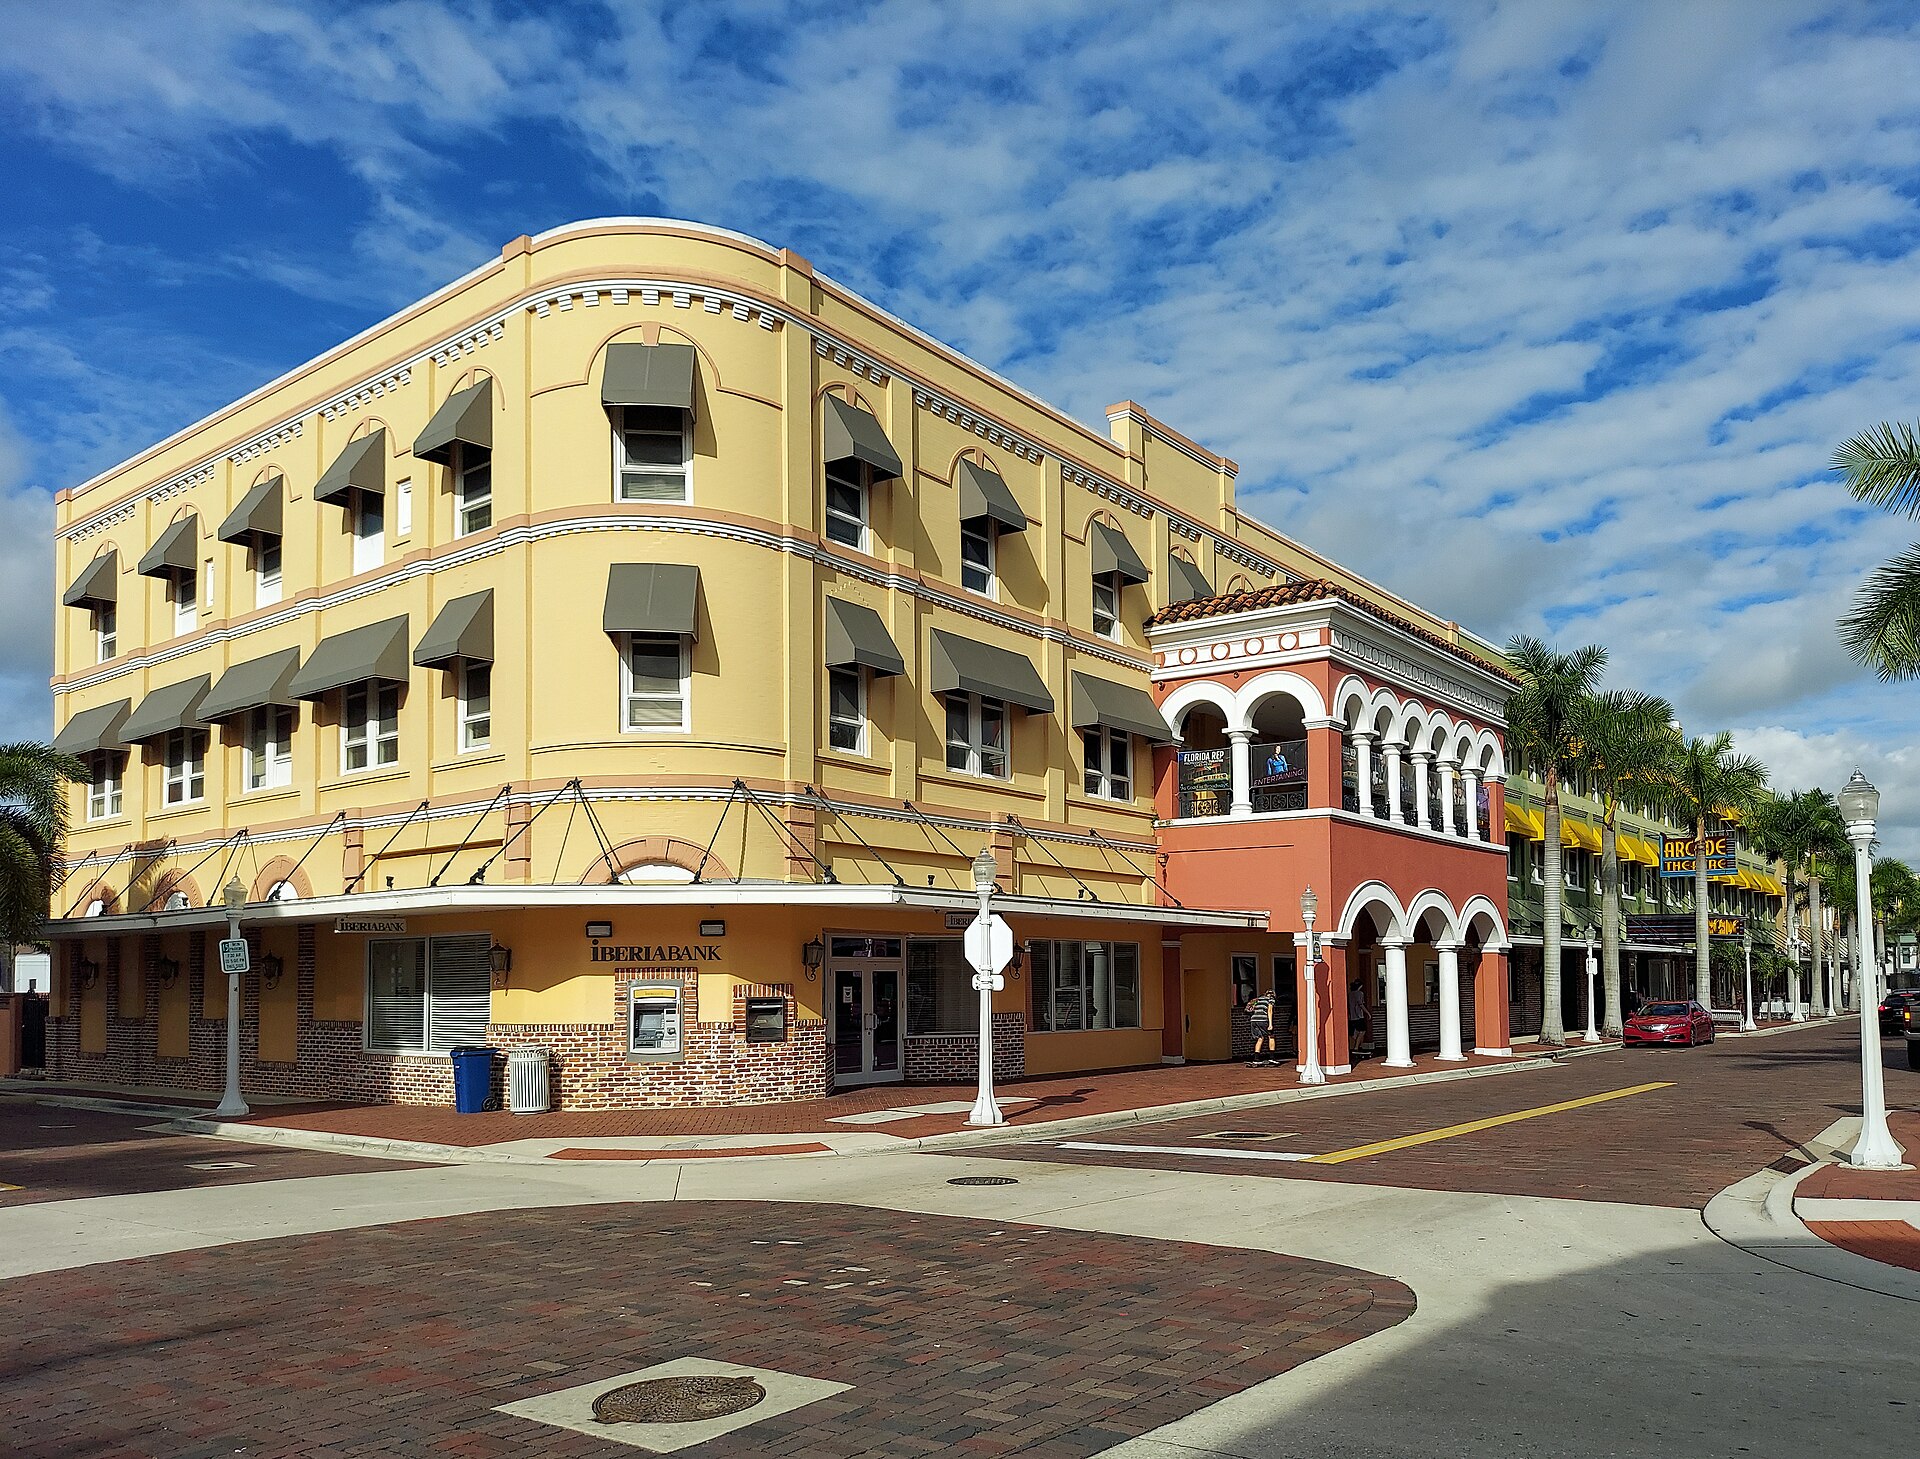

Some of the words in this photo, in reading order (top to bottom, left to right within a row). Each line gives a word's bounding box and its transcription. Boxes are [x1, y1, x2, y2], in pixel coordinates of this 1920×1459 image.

[1184, 752, 1210, 762] FLORIDA
[1211, 750, 1225, 760] REP
[1664, 838, 1726, 858] ARCDE
[1664, 858, 1726, 872] THERE
[222, 943, 229, 952] 15
